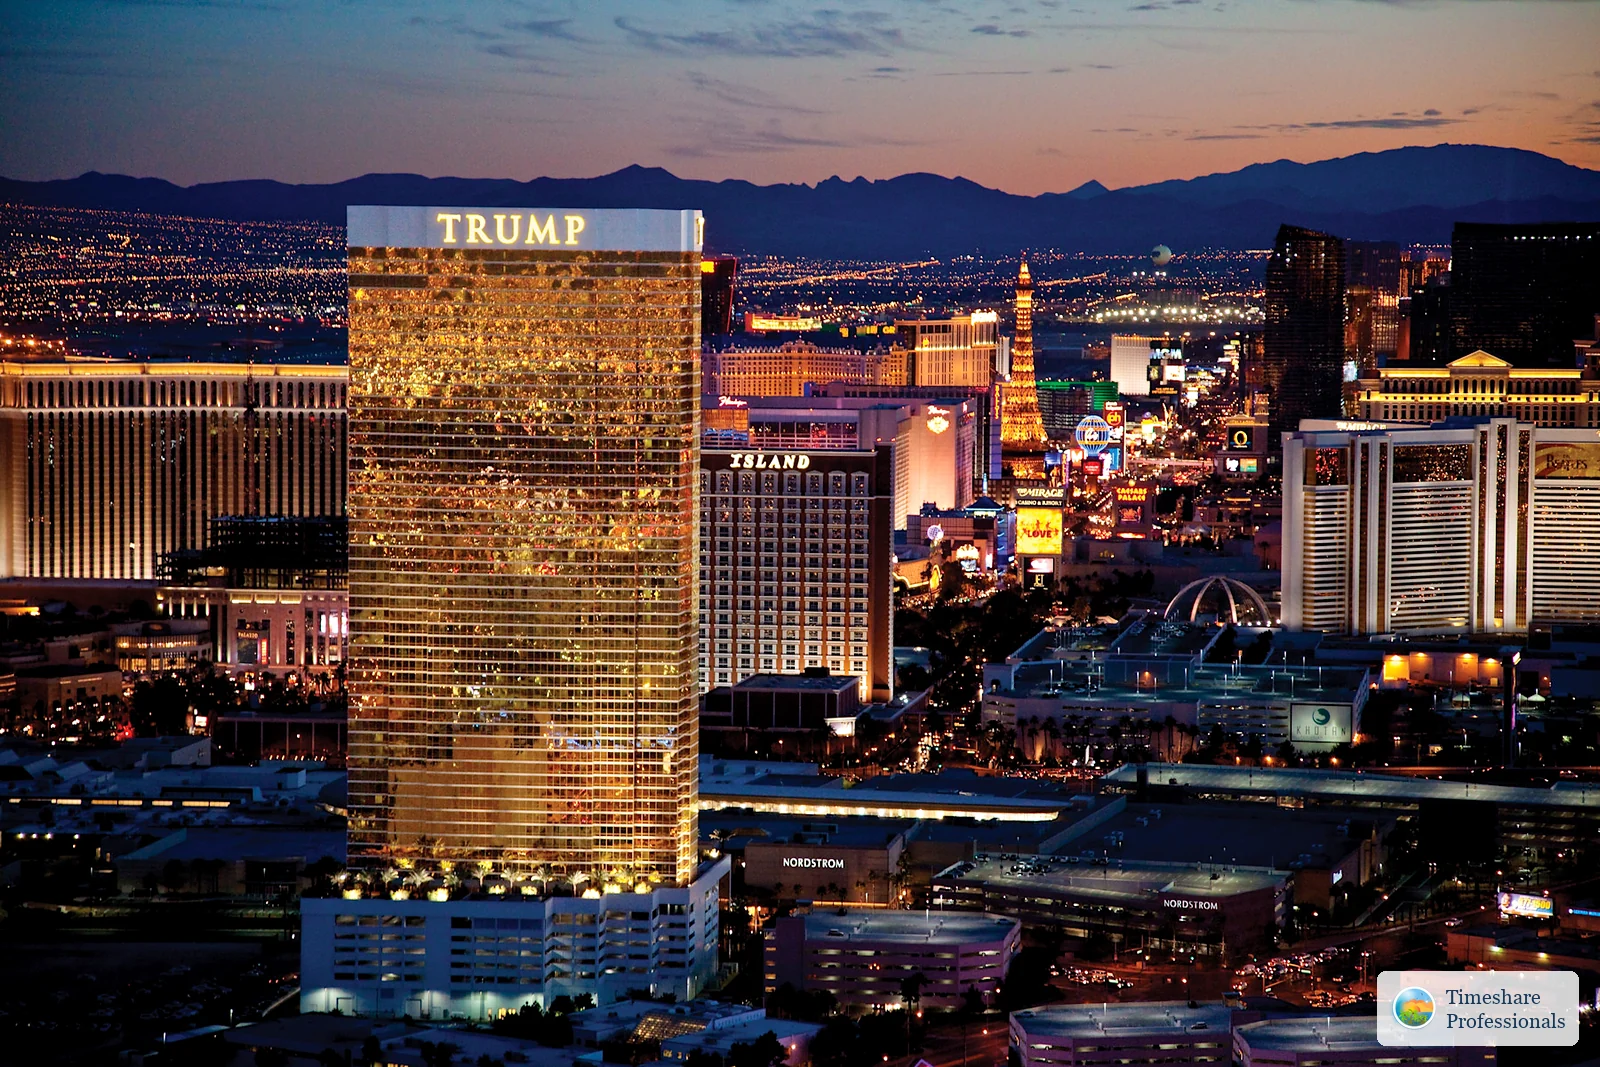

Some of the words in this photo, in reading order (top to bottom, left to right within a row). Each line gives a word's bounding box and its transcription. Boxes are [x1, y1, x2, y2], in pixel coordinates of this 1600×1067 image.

[437, 213, 586, 246] TRUMP
[729, 453, 811, 469] ISLAND
[1028, 488, 1064, 498] MIRAGE
[1116, 487, 1147, 495] CAESARS
[1027, 529, 1052, 538] LOVE
[1296, 725, 1346, 736] KHOTAN
[783, 857, 844, 869] NORDSTROM
[1163, 899, 1218, 910] NORDSTROM
